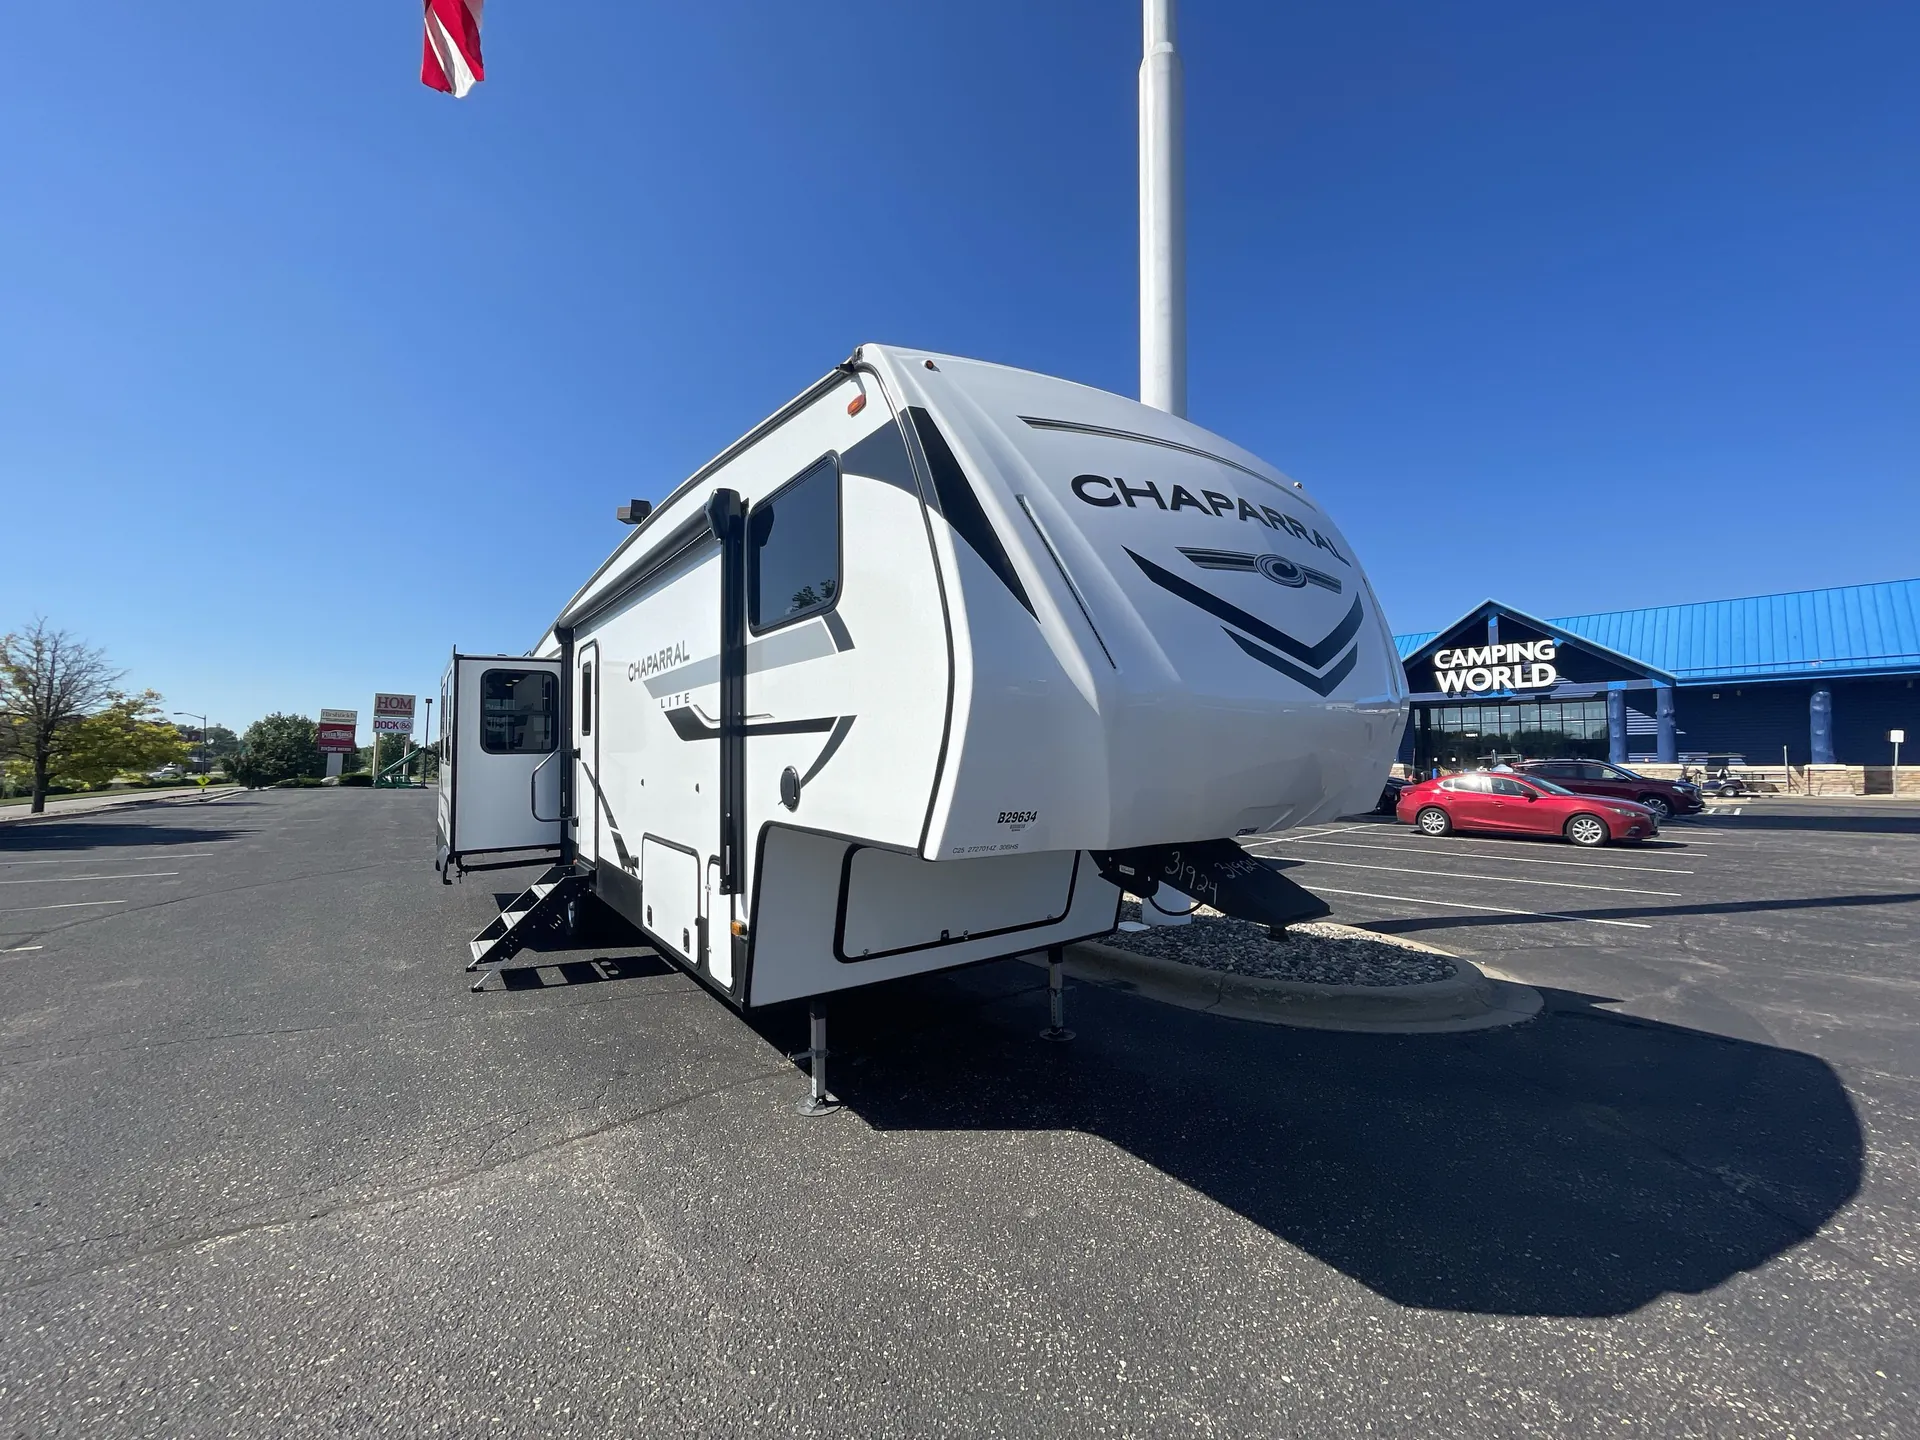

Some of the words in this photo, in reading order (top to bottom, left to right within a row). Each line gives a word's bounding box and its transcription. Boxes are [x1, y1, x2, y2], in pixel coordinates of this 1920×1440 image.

[1071, 474, 1351, 568] CHAPARRAL
[628, 640, 690, 682] CHAPARRAL
[1434, 640, 1556, 669] CAMPING
[1435, 663, 1557, 693] WORLD
[377, 697, 412, 709] HOM
[660, 692, 690, 709] LITE
[374, 720, 399, 729] DOCK
[997, 811, 1038, 824] B29634
[1164, 851, 1218, 905] 31924
